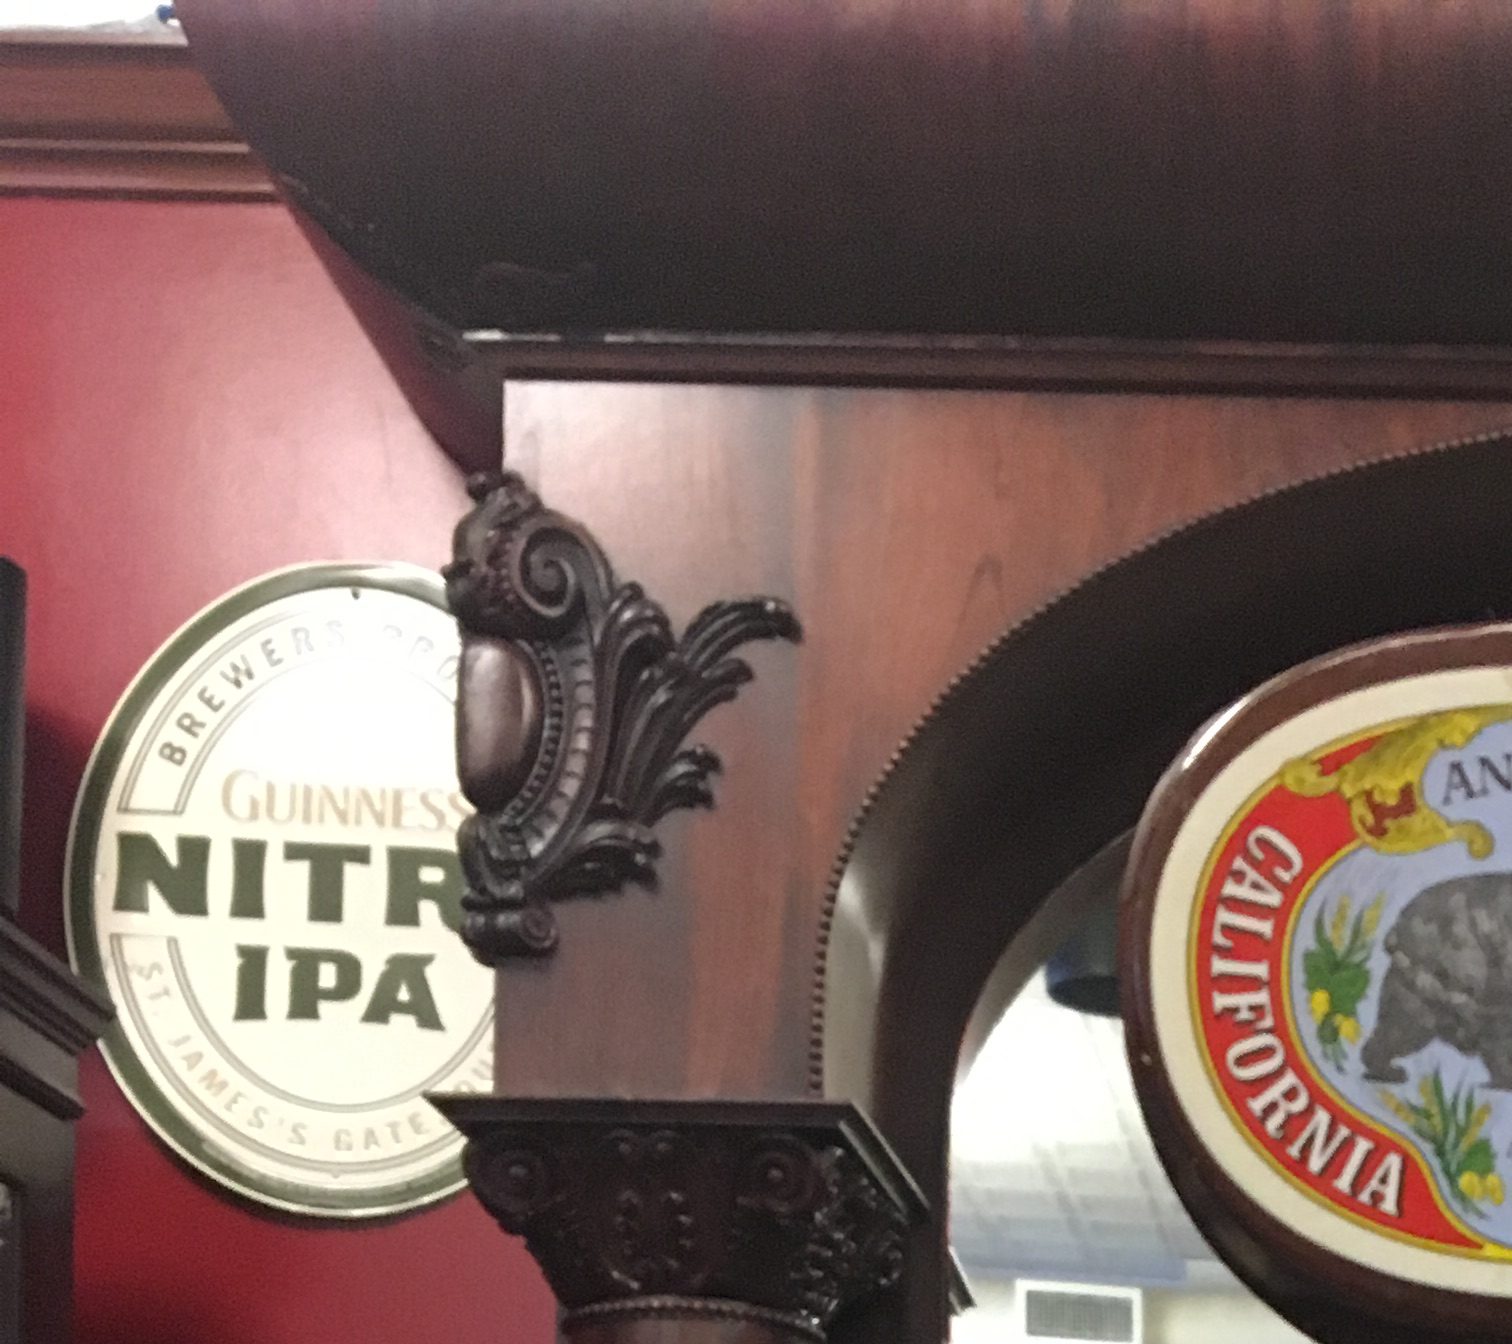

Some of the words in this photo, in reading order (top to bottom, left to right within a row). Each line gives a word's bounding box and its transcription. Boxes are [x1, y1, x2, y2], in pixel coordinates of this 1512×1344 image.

[157, 619, 347, 767] BREWERS
[232, 943, 447, 1033] IPA
[1210, 824, 1406, 1218] CALIFORNIA
[167, 1033, 308, 1148] JAMES'S
